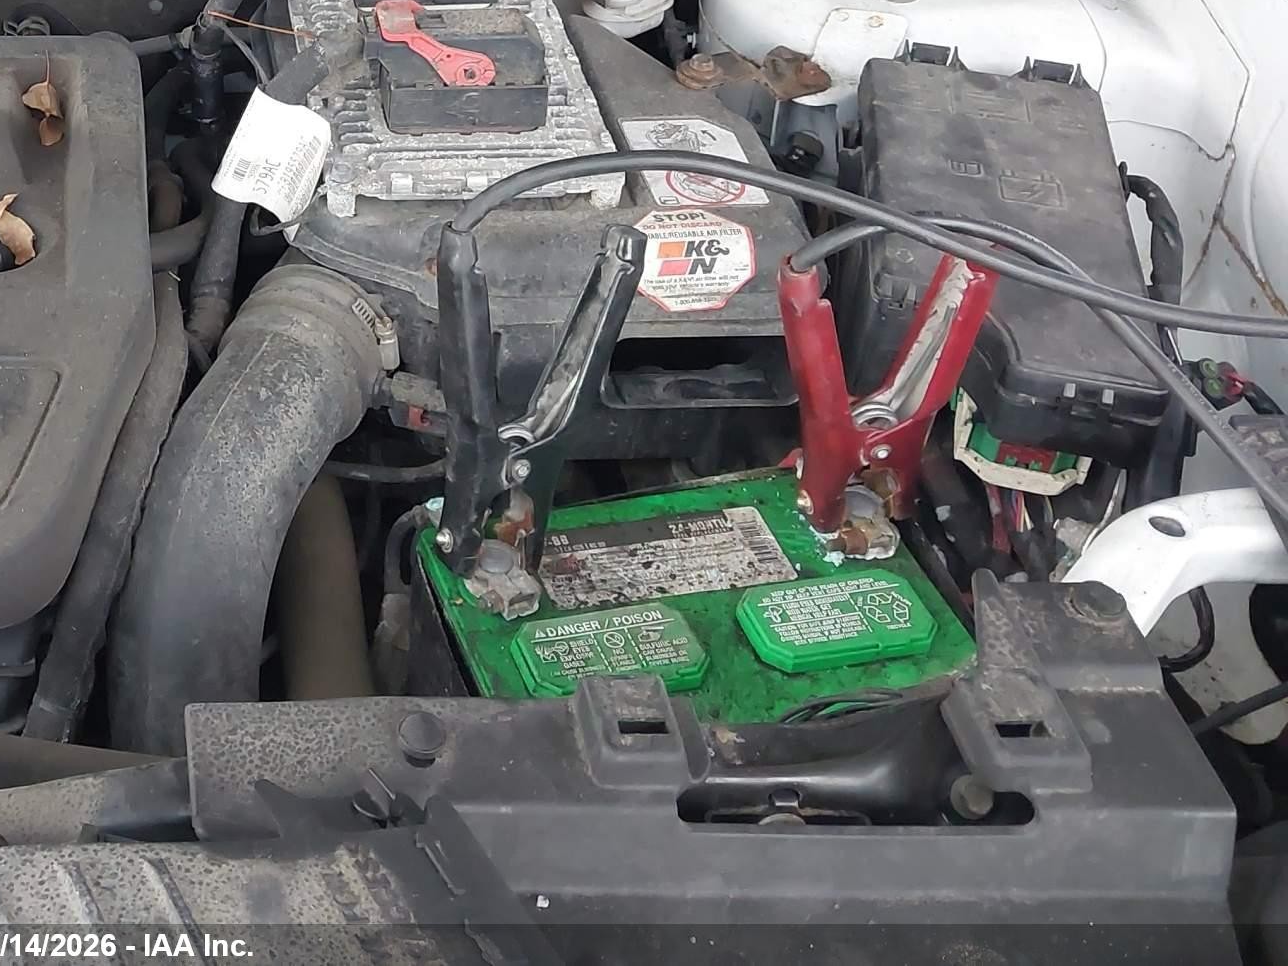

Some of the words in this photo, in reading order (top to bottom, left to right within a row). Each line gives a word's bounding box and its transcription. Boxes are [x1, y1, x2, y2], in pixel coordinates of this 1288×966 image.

[652, 212, 706, 222] STOP!
[720, 228, 743, 236] FILTER
[546, 621, 600, 637] DANGER
[612, 610, 662, 626] POISON
